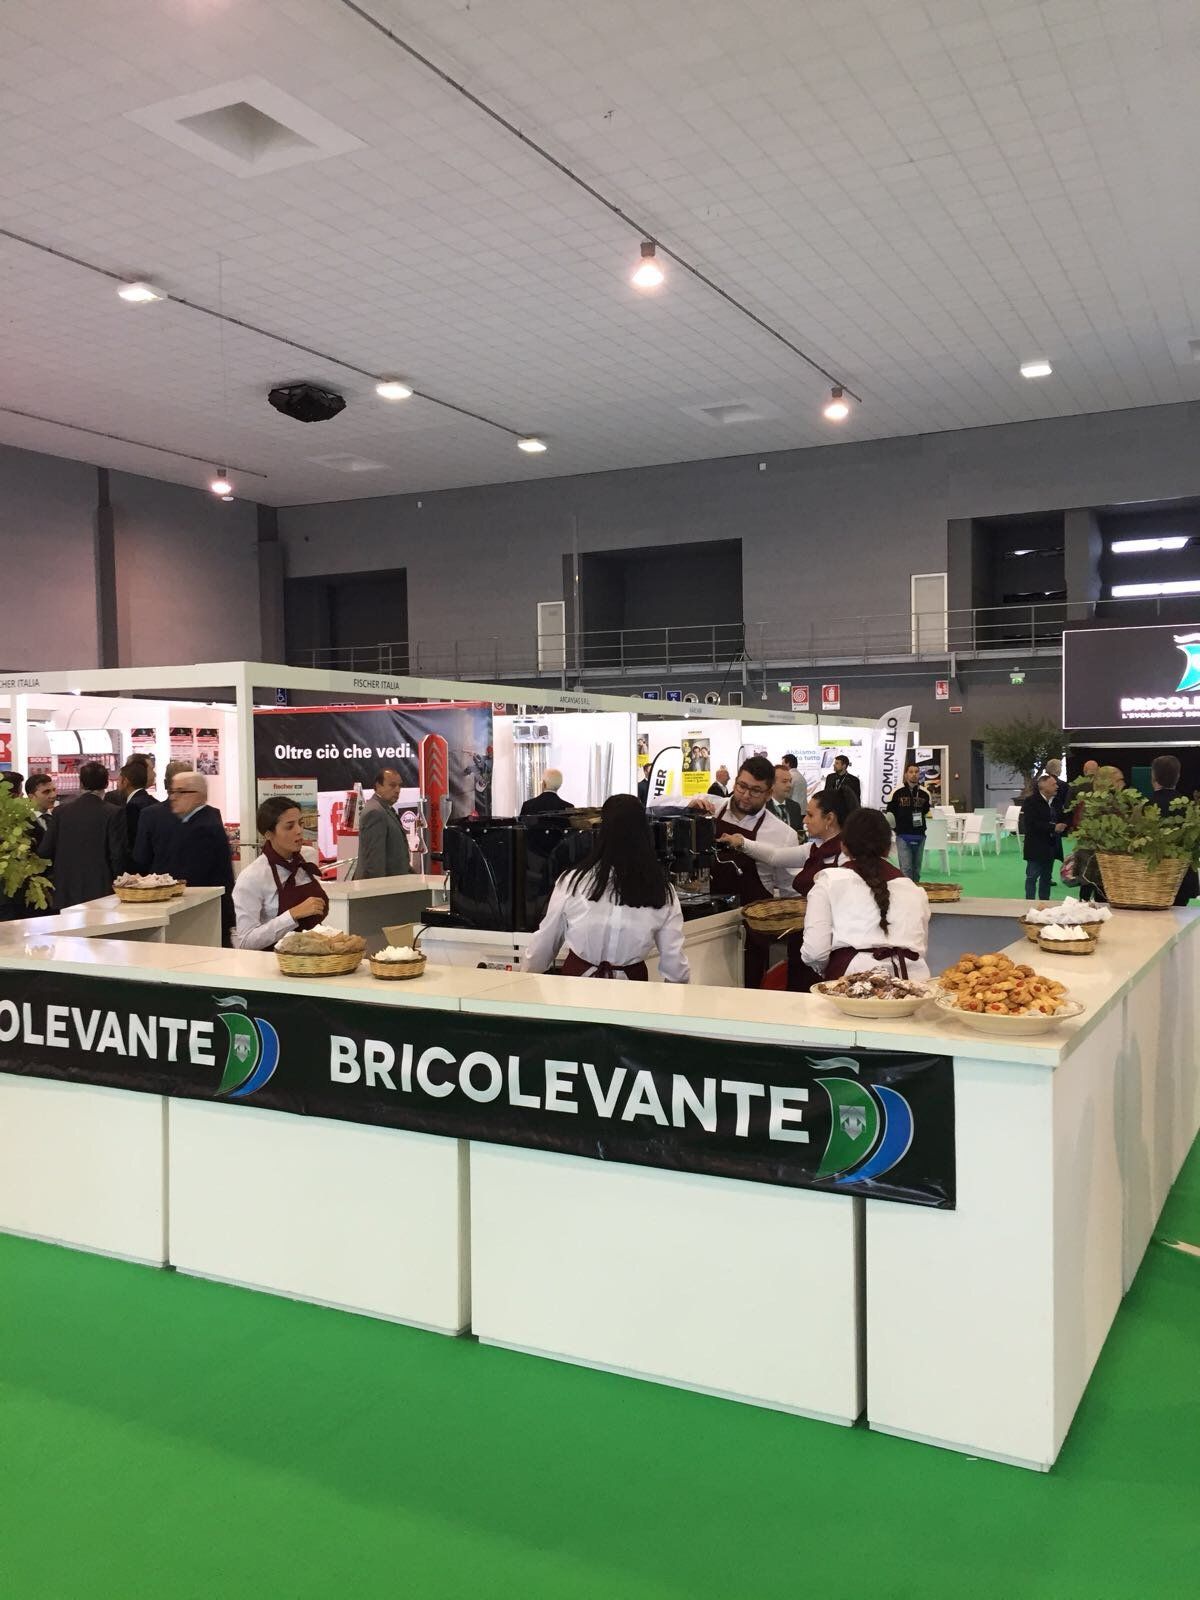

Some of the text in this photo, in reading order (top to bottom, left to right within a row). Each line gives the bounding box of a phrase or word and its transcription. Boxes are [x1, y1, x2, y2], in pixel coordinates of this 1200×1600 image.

[17, 679, 40, 688] ITALIA
[353, 679, 400, 690] FISCHER ITALIA
[274, 743, 416, 760] Oltre ciò che vedi.
[881, 717, 898, 805] COMUNELLO
[0, 999, 216, 1067] OLEVANTE
[329, 1034, 810, 1144] BRICOLEVANTE
